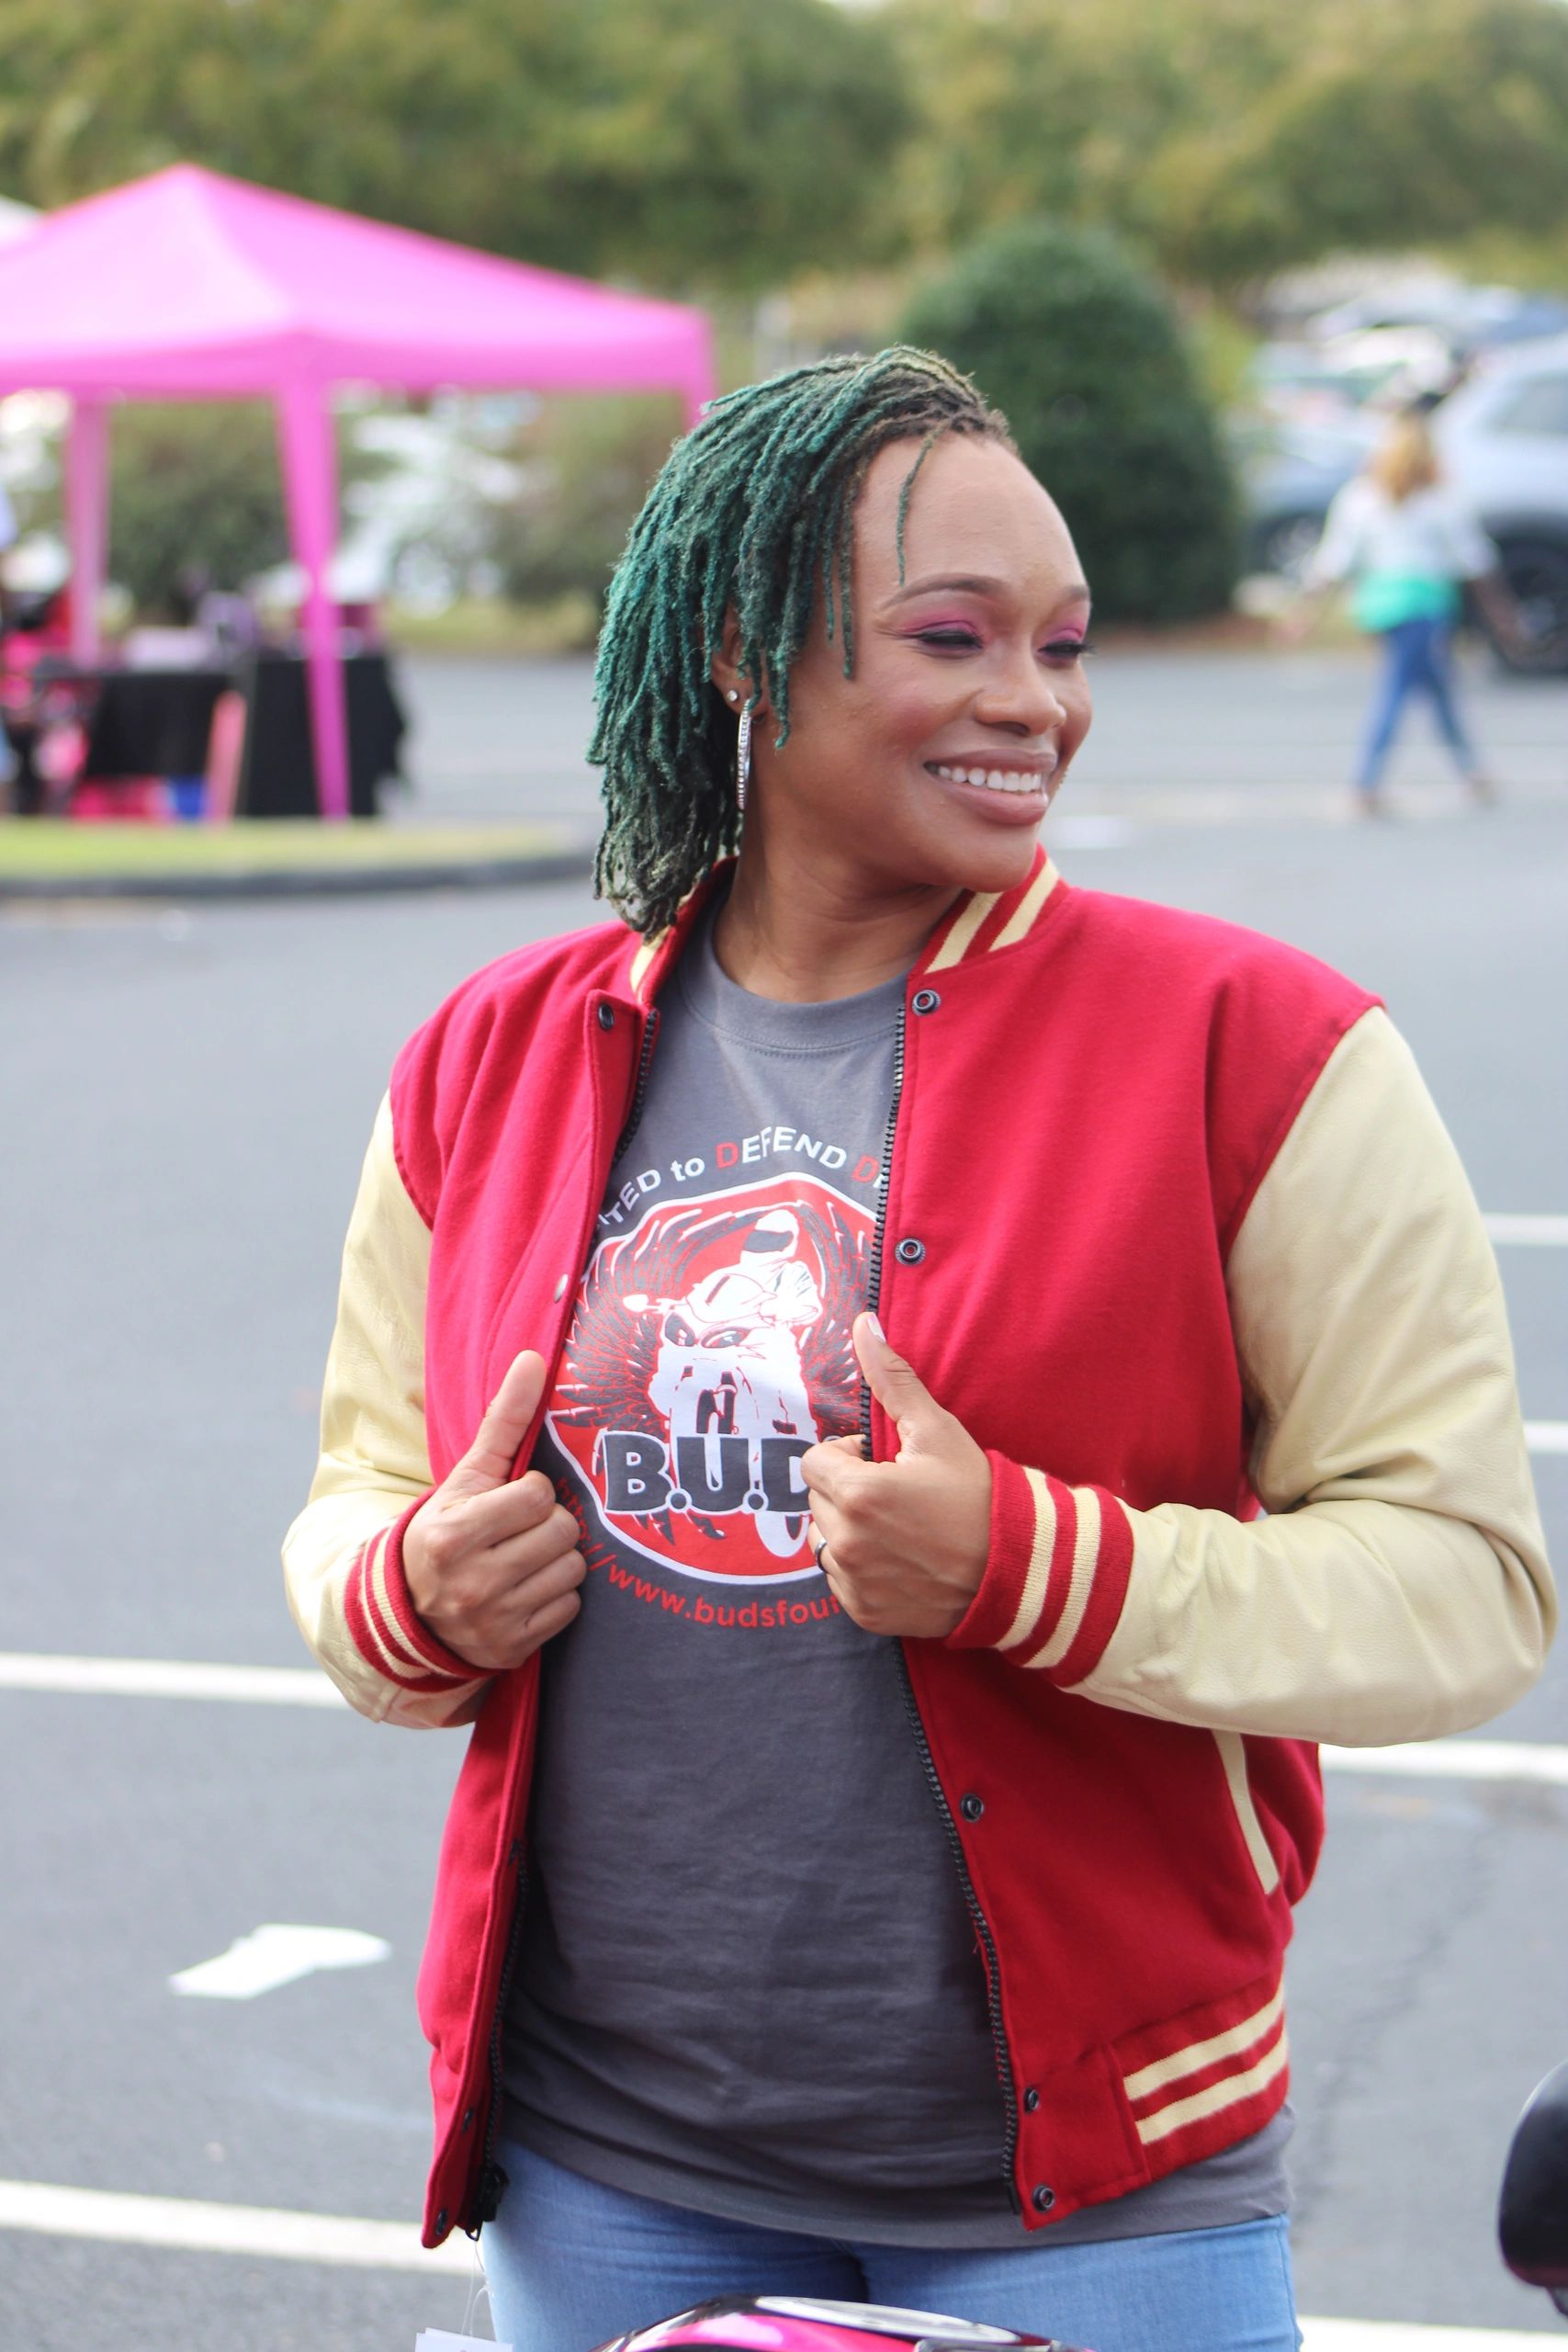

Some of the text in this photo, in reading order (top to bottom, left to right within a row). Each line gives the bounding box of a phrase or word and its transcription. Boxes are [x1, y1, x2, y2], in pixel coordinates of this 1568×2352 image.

[596, 1169, 661, 1227] ITED
[670, 1157, 705, 1182] to
[715, 1125, 848, 1170] DEFEND
[603, 1430, 820, 1517] B.U.D
